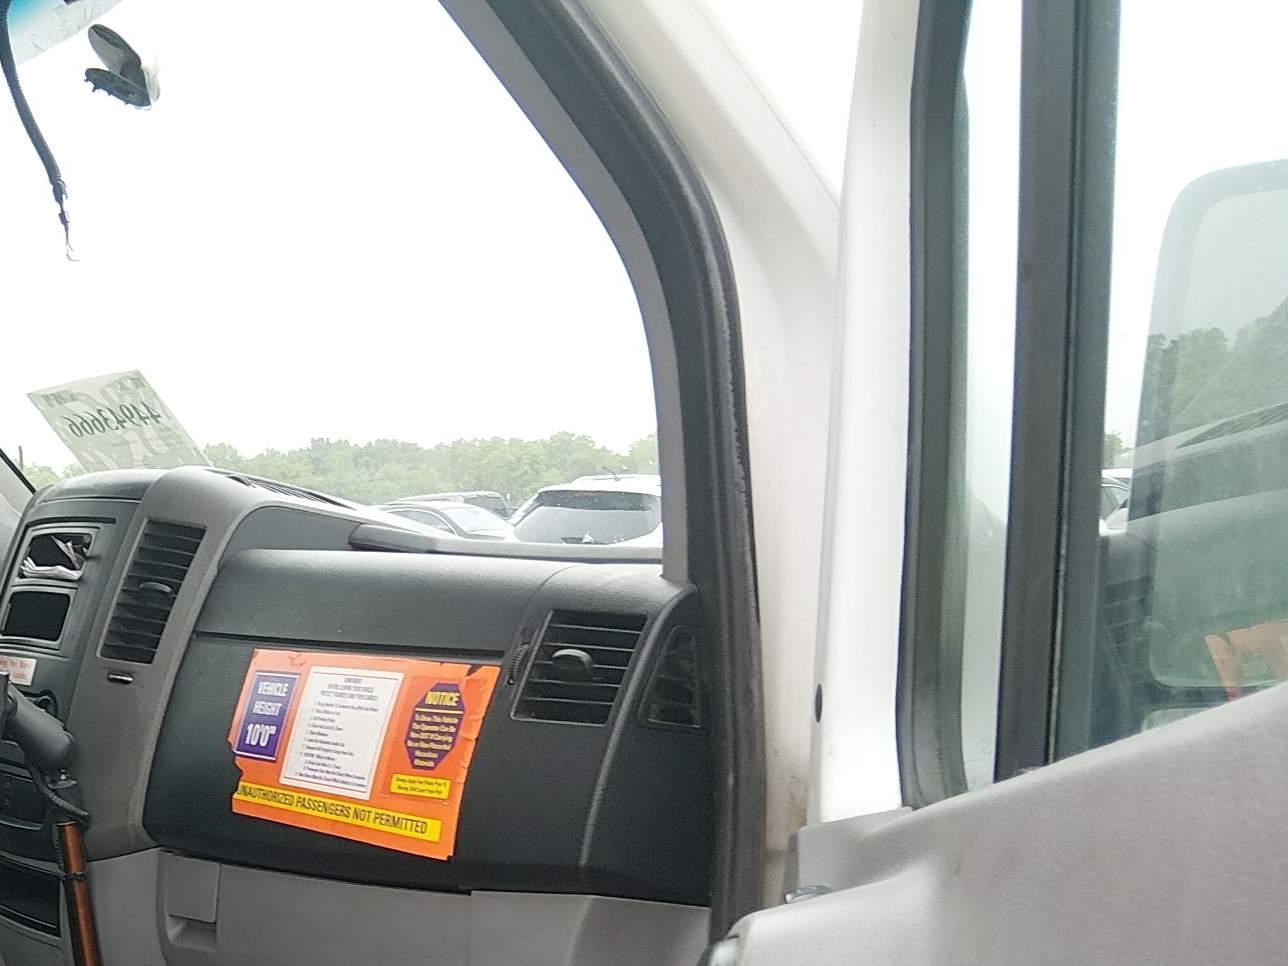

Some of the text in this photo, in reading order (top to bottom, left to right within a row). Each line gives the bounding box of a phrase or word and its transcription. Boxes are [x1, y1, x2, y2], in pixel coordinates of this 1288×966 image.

[257, 681, 289, 697] VEHICLE
[425, 692, 460, 706] NOTICE
[252, 701, 282, 717] HEIGHT
[295, 796, 350, 818] PASSENGERS
[352, 808, 373, 825] NOT
[374, 813, 428, 835] PERMITTED
